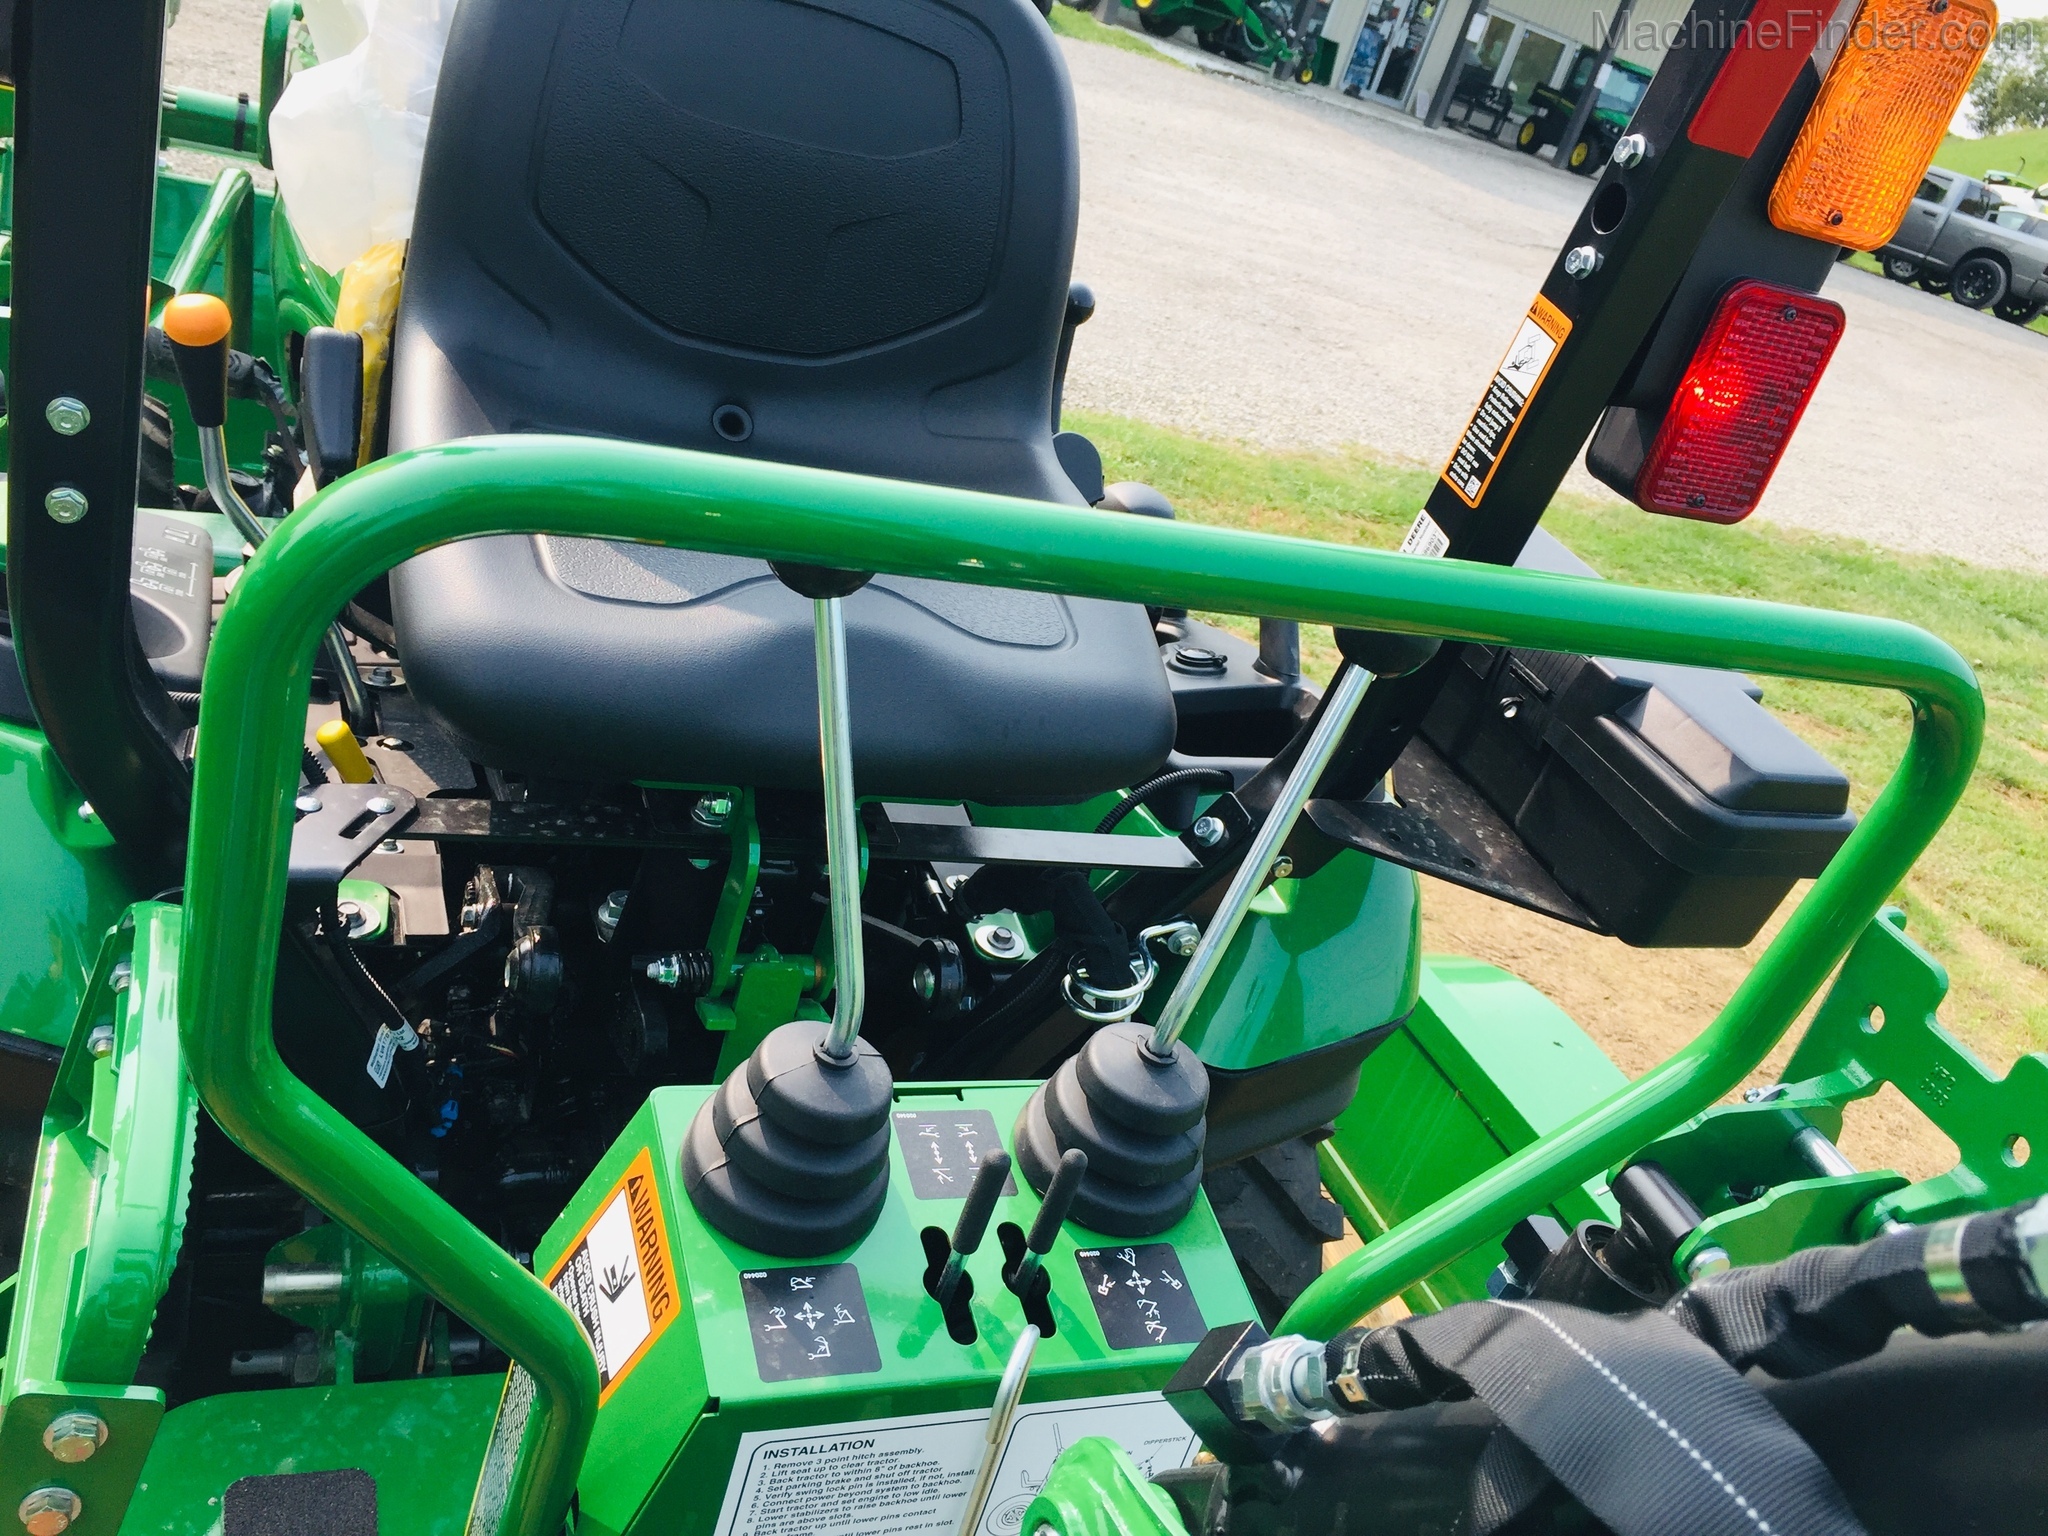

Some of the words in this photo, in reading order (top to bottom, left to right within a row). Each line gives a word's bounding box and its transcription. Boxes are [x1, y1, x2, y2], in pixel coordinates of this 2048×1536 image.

[1536, 306, 1565, 338] WARNING
[1407, 514, 1426, 546] DEERE
[575, 1256, 582, 1277] OR
[632, 1188, 670, 1323] WARNING
[578, 1276, 589, 1318] DEATH
[581, 1248, 591, 1285] AVOID
[588, 1285, 599, 1326] CRUSH
[594, 1328, 606, 1373] INJURY
[762, 1438, 875, 1460] INSTALLATION
[1144, 1436, 1187, 1445] DIPPERSTICK
[771, 1469, 788, 1477] Lift
[790, 1467, 811, 1475] seat
[840, 1461, 864, 1469] clear
[773, 1460, 813, 1469] Remove
[823, 1455, 849, 1465] point
[851, 1452, 875, 1460] hitch
[769, 1476, 793, 1484] Back
[796, 1473, 828, 1481] tractor
[843, 1467, 872, 1476] within
[785, 1481, 822, 1491] parking
[824, 1477, 851, 1485] brake
[853, 1474, 872, 1482] and
[874, 1471, 895, 1479] shut
[897, 1469, 911, 1477] off
[912, 1467, 942, 1475] tractor
[762, 1497, 803, 1507] Connect
[805, 1493, 835, 1503] power
[837, 1488, 873, 1498] beyond
[874, 1485, 908, 1494] system
[765, 1490, 793, 1500] Verify
[795, 1486, 823, 1496] swing
[825, 1484, 845, 1492] lock
[847, 1483, 863, 1491] pin
[876, 1476, 916, 1486] installed,
[758, 1514, 788, 1522] Lower
[790, 1507, 839, 1518] stabilizers
[853, 1501, 876, 1510] raise
[878, 1497, 918, 1507] backhoe
[920, 1494, 940, 1502] until
[942, 1491, 967, 1499] lower
[760, 1506, 784, 1514] Start
[786, 1503, 818, 1511] tractor
[820, 1499, 839, 1507] and
[857, 1493, 889, 1502] engine
[753, 1528, 777, 1536] Back
[780, 1524, 812, 1533] tractor
[829, 1518, 850, 1527] until
[852, 1516, 878, 1524] lower
[879, 1513, 900, 1521] pins
[902, 1508, 936, 1517] contact
[755, 1522, 776, 1531] pins
[797, 1516, 826, 1524] above
[883, 1526, 902, 1534] pins
